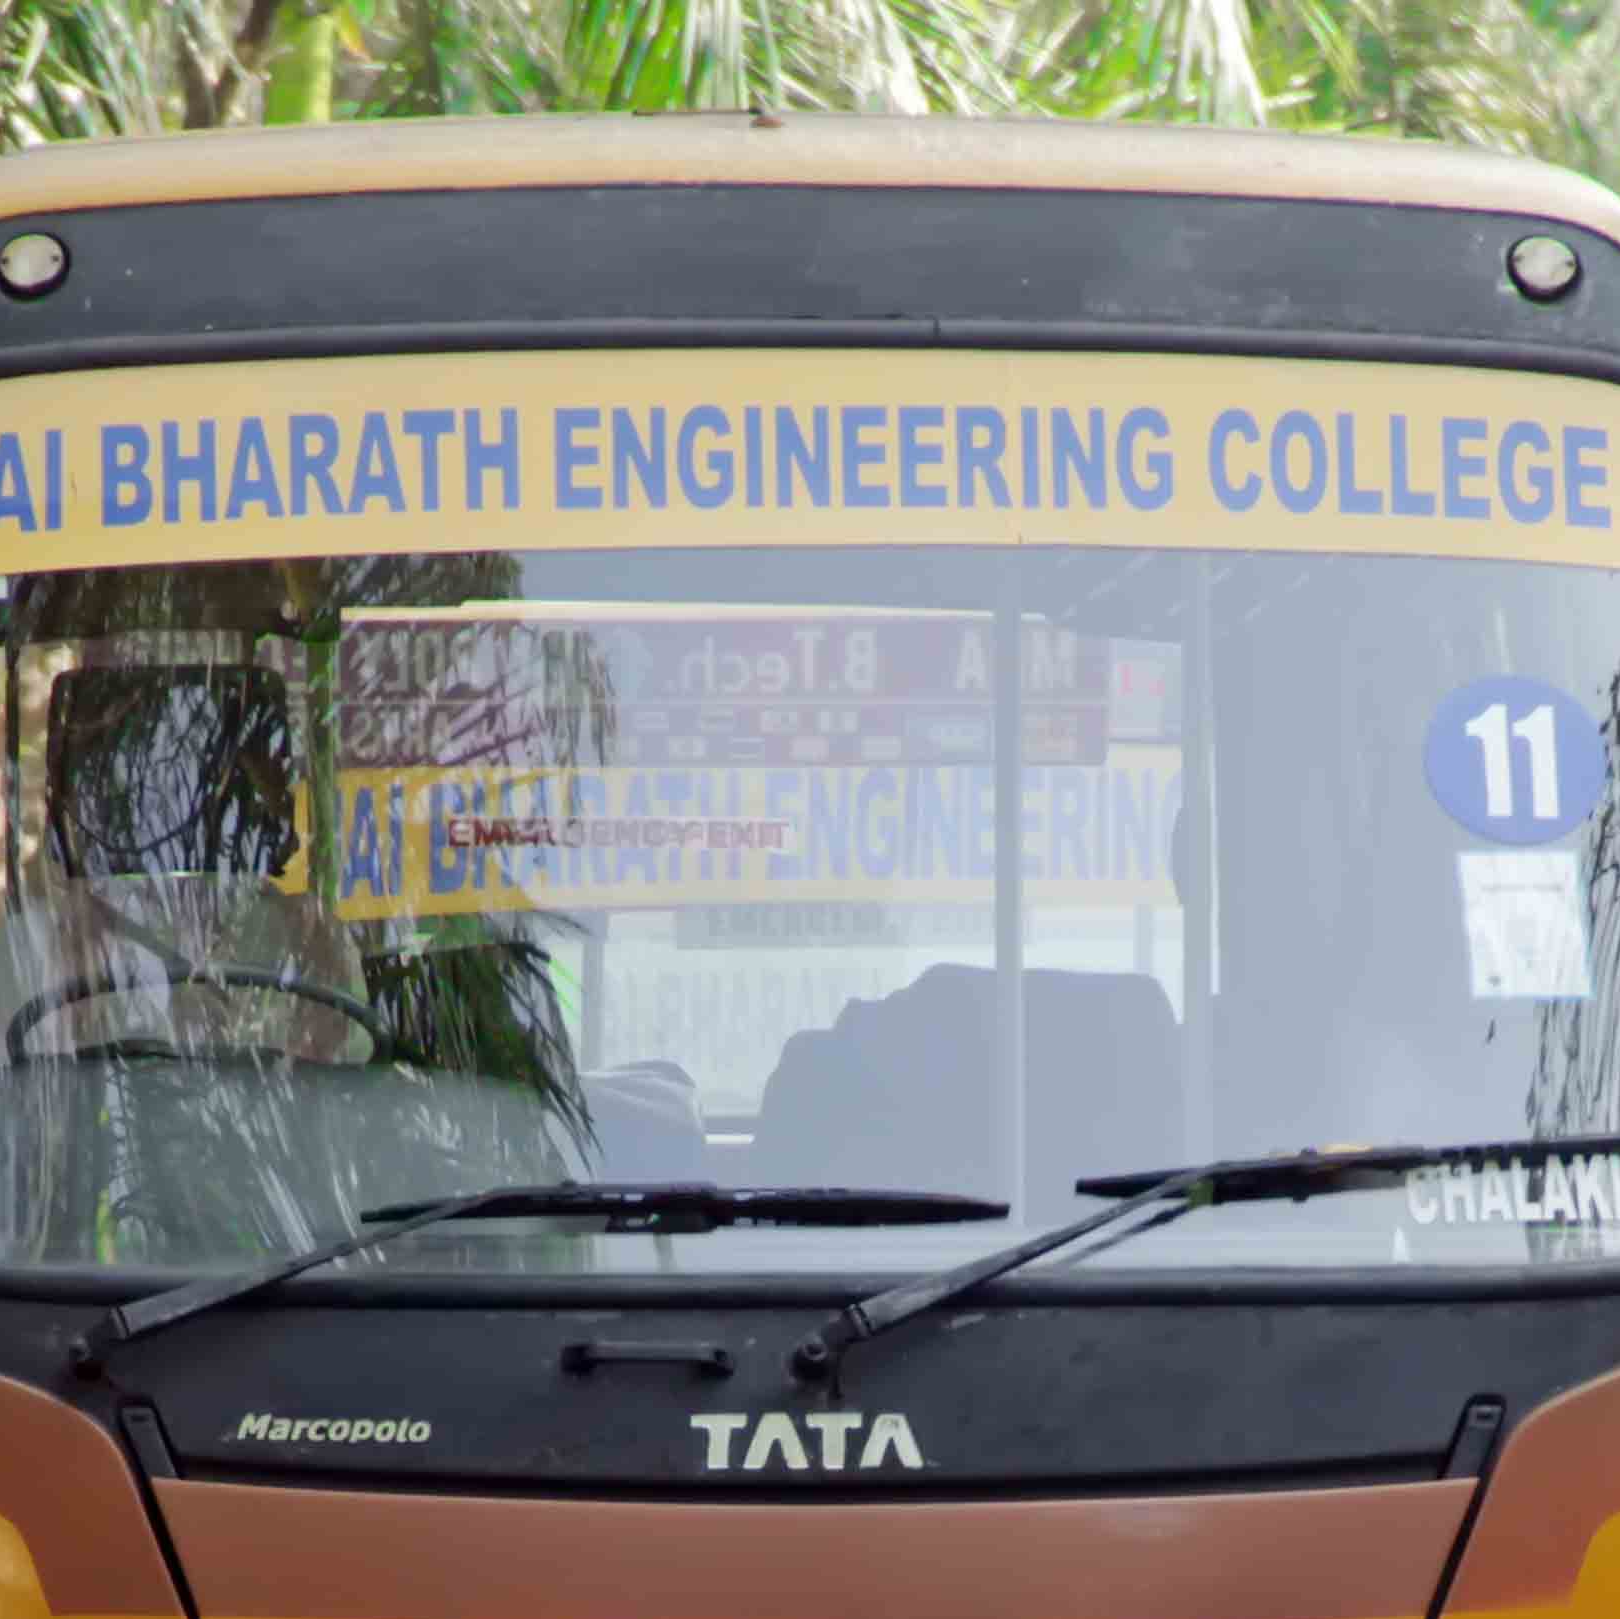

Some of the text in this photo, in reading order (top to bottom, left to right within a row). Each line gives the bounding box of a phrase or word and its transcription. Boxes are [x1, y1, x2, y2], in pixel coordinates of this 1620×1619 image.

[100, 406, 521, 528] BHARATH
[554, 403, 1175, 512] ENGINEERING
[1207, 408, 1613, 530] COLLEGE
[1465, 703, 1560, 820] 11
[236, 1412, 432, 1445] Marcopolo
[689, 1412, 924, 1471] TATA
